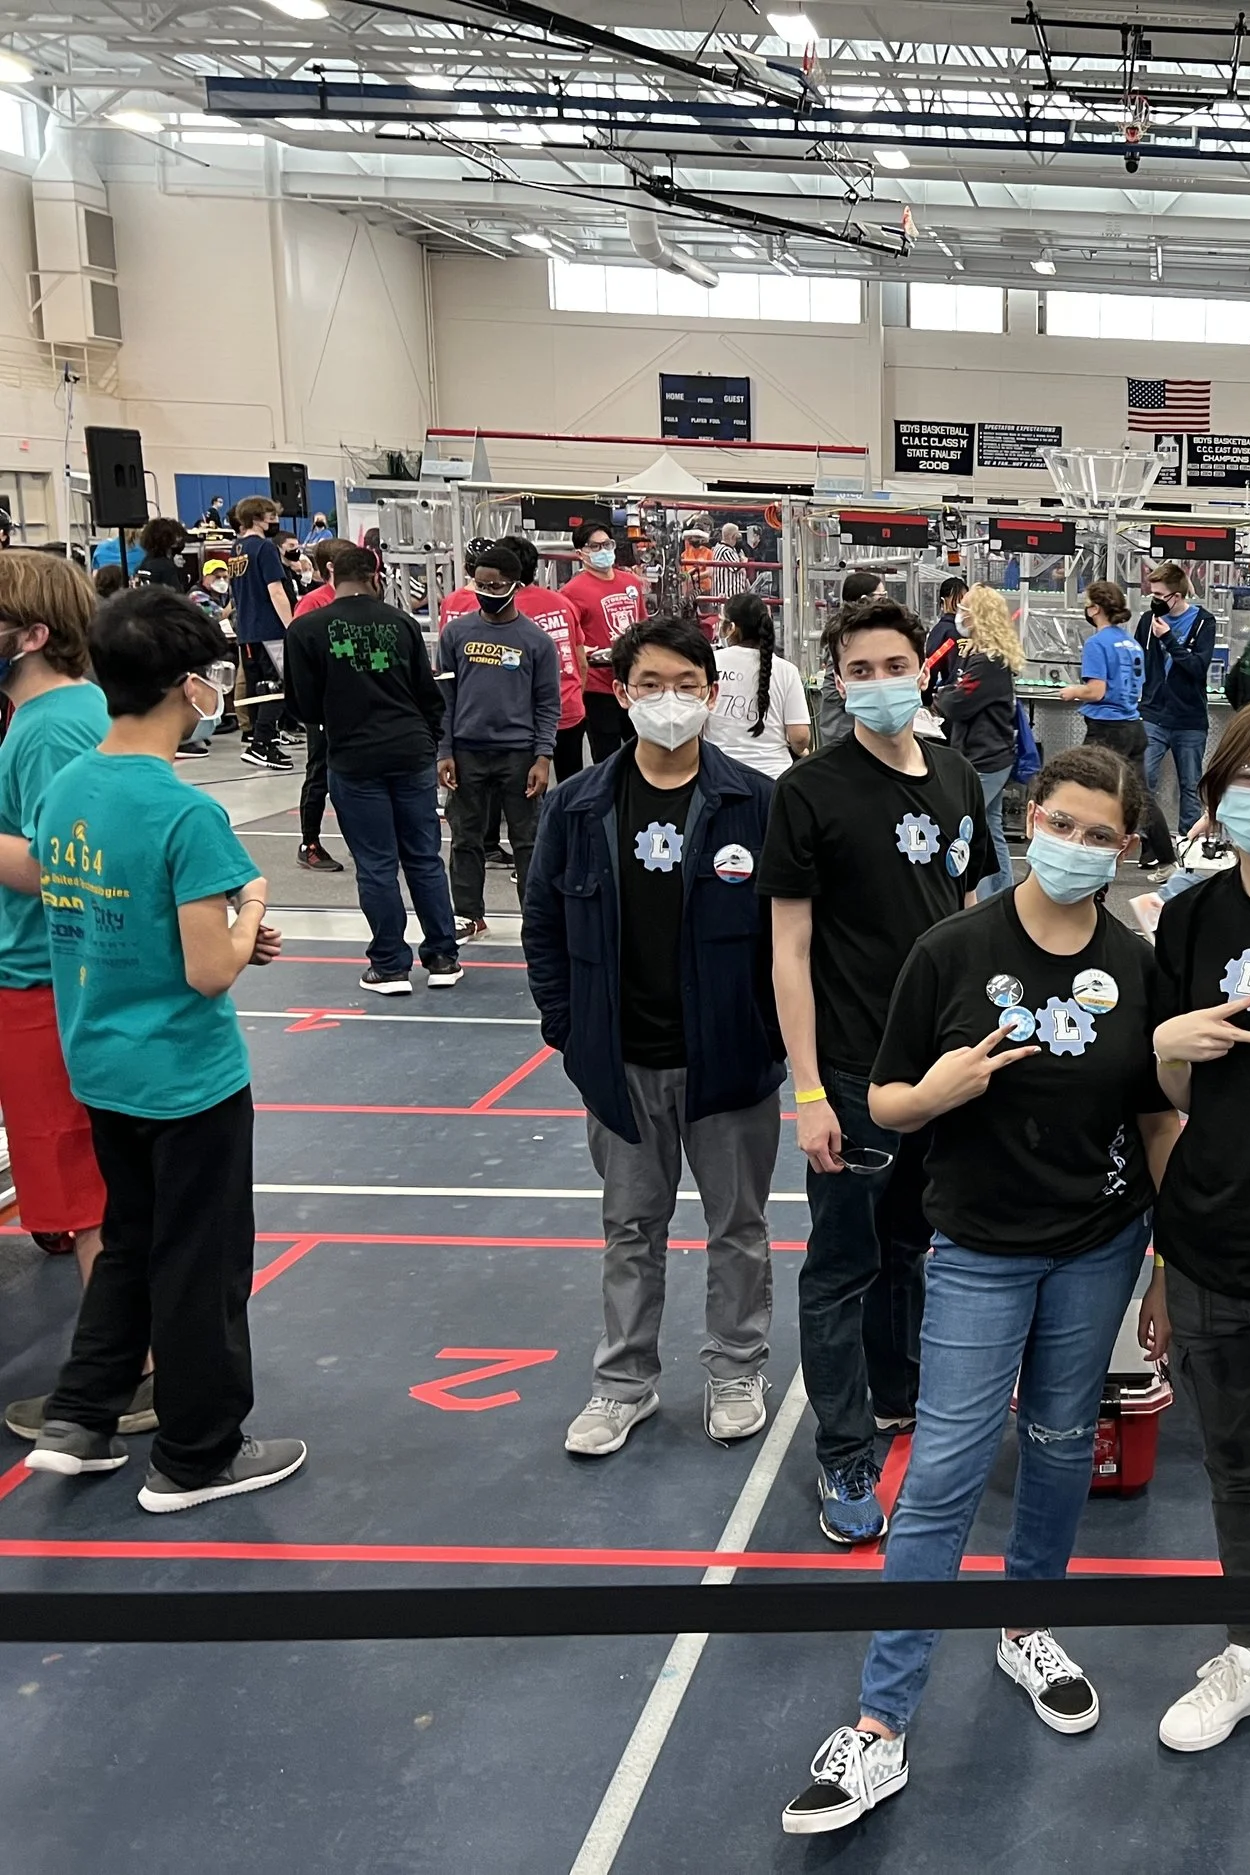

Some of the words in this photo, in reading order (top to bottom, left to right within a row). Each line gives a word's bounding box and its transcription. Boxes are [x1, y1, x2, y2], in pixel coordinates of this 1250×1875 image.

[724, 395, 744, 403] GUEST
[900, 424, 920, 433] BOYS
[921, 425, 969, 436] BASKETBALL
[930, 438, 958, 448] CLASS
[1193, 436, 1212, 444] BOYS
[906, 448, 929, 458] STATE
[930, 449, 962, 459] FINALIST
[1203, 454, 1249, 463] CHAMPIONS
[919, 460, 949, 470] 2008
[469, 656, 503, 666] ROBOT
[908, 825, 927, 851] L
[652, 833, 670, 859] L
[1053, 1010, 1080, 1040] L
